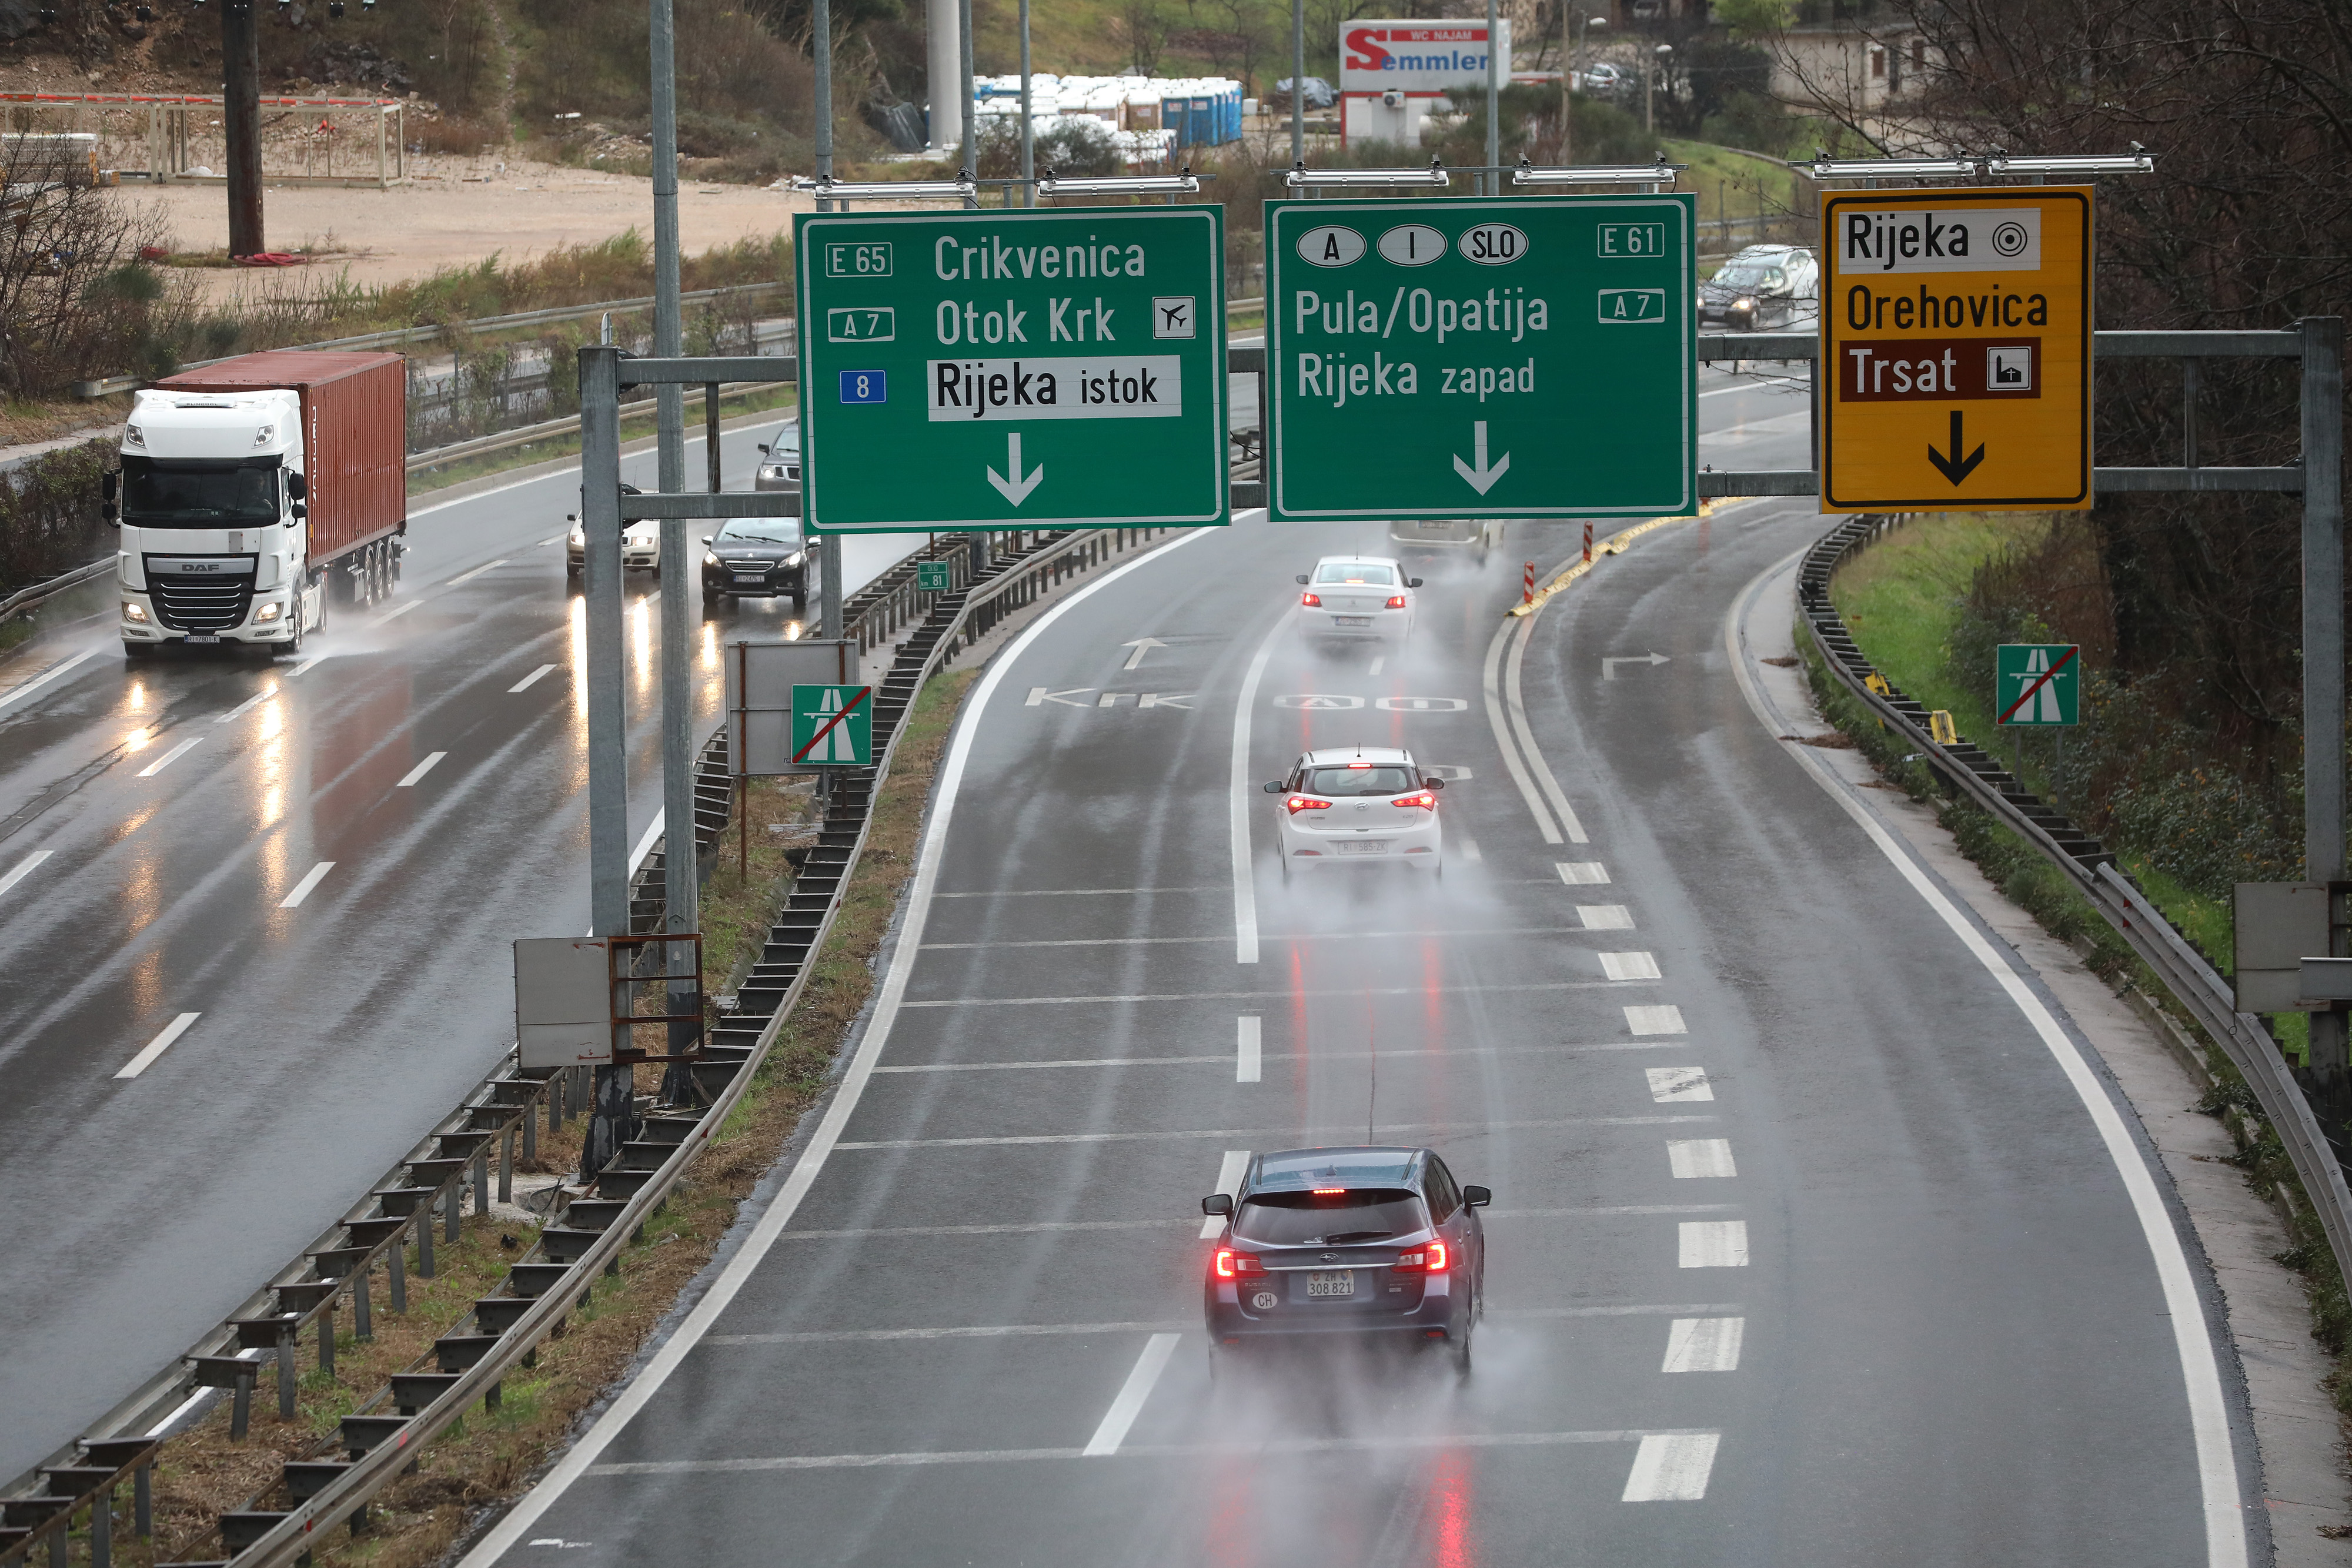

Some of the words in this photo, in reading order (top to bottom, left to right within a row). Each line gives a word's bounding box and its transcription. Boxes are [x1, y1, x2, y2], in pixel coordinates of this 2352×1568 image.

[1411, 31, 1429, 40] WC
[1434, 30, 1472, 40] NAJAM
[1346, 28, 1488, 71] Semmler
[1324, 233, 1340, 260] A
[1409, 232, 1414, 259] I
[1472, 230, 1515, 259] SLO
[1604, 228, 1617, 253] E
[1627, 227, 1654, 253] 61
[1848, 213, 1969, 270] Rijeka
[833, 248, 845, 272] E
[856, 246, 886, 272] 65
[935, 235, 1145, 280] Crikvenica
[1296, 286, 1548, 344] Pula/Opatija
[1614, 296, 1627, 317] A
[1638, 295, 1649, 317] 7
[1847, 284, 2047, 330] Orehovica
[844, 315, 857, 336] A
[867, 313, 877, 335] 7
[937, 299, 1028, 345] Otok
[1050, 297, 1116, 342] Krk
[1299, 352, 1418, 407] Rijeka
[1441, 357, 1535, 403] zapad
[1849, 347, 1957, 393] Trsat
[856, 376, 869, 398] 8
[937, 362, 1057, 418] Rijeka
[1082, 368, 1158, 404] istok
[933, 575, 941, 586] 81
[1024, 687, 1197, 709] Krk
[1359, 842, 1385, 851] 585-ZK
[1309, 1283, 1329, 1295] 308
[1332, 1282, 1351, 1294] 821
[1325, 1273, 1336, 1281] ZH
[1258, 1295, 1272, 1306] CH
